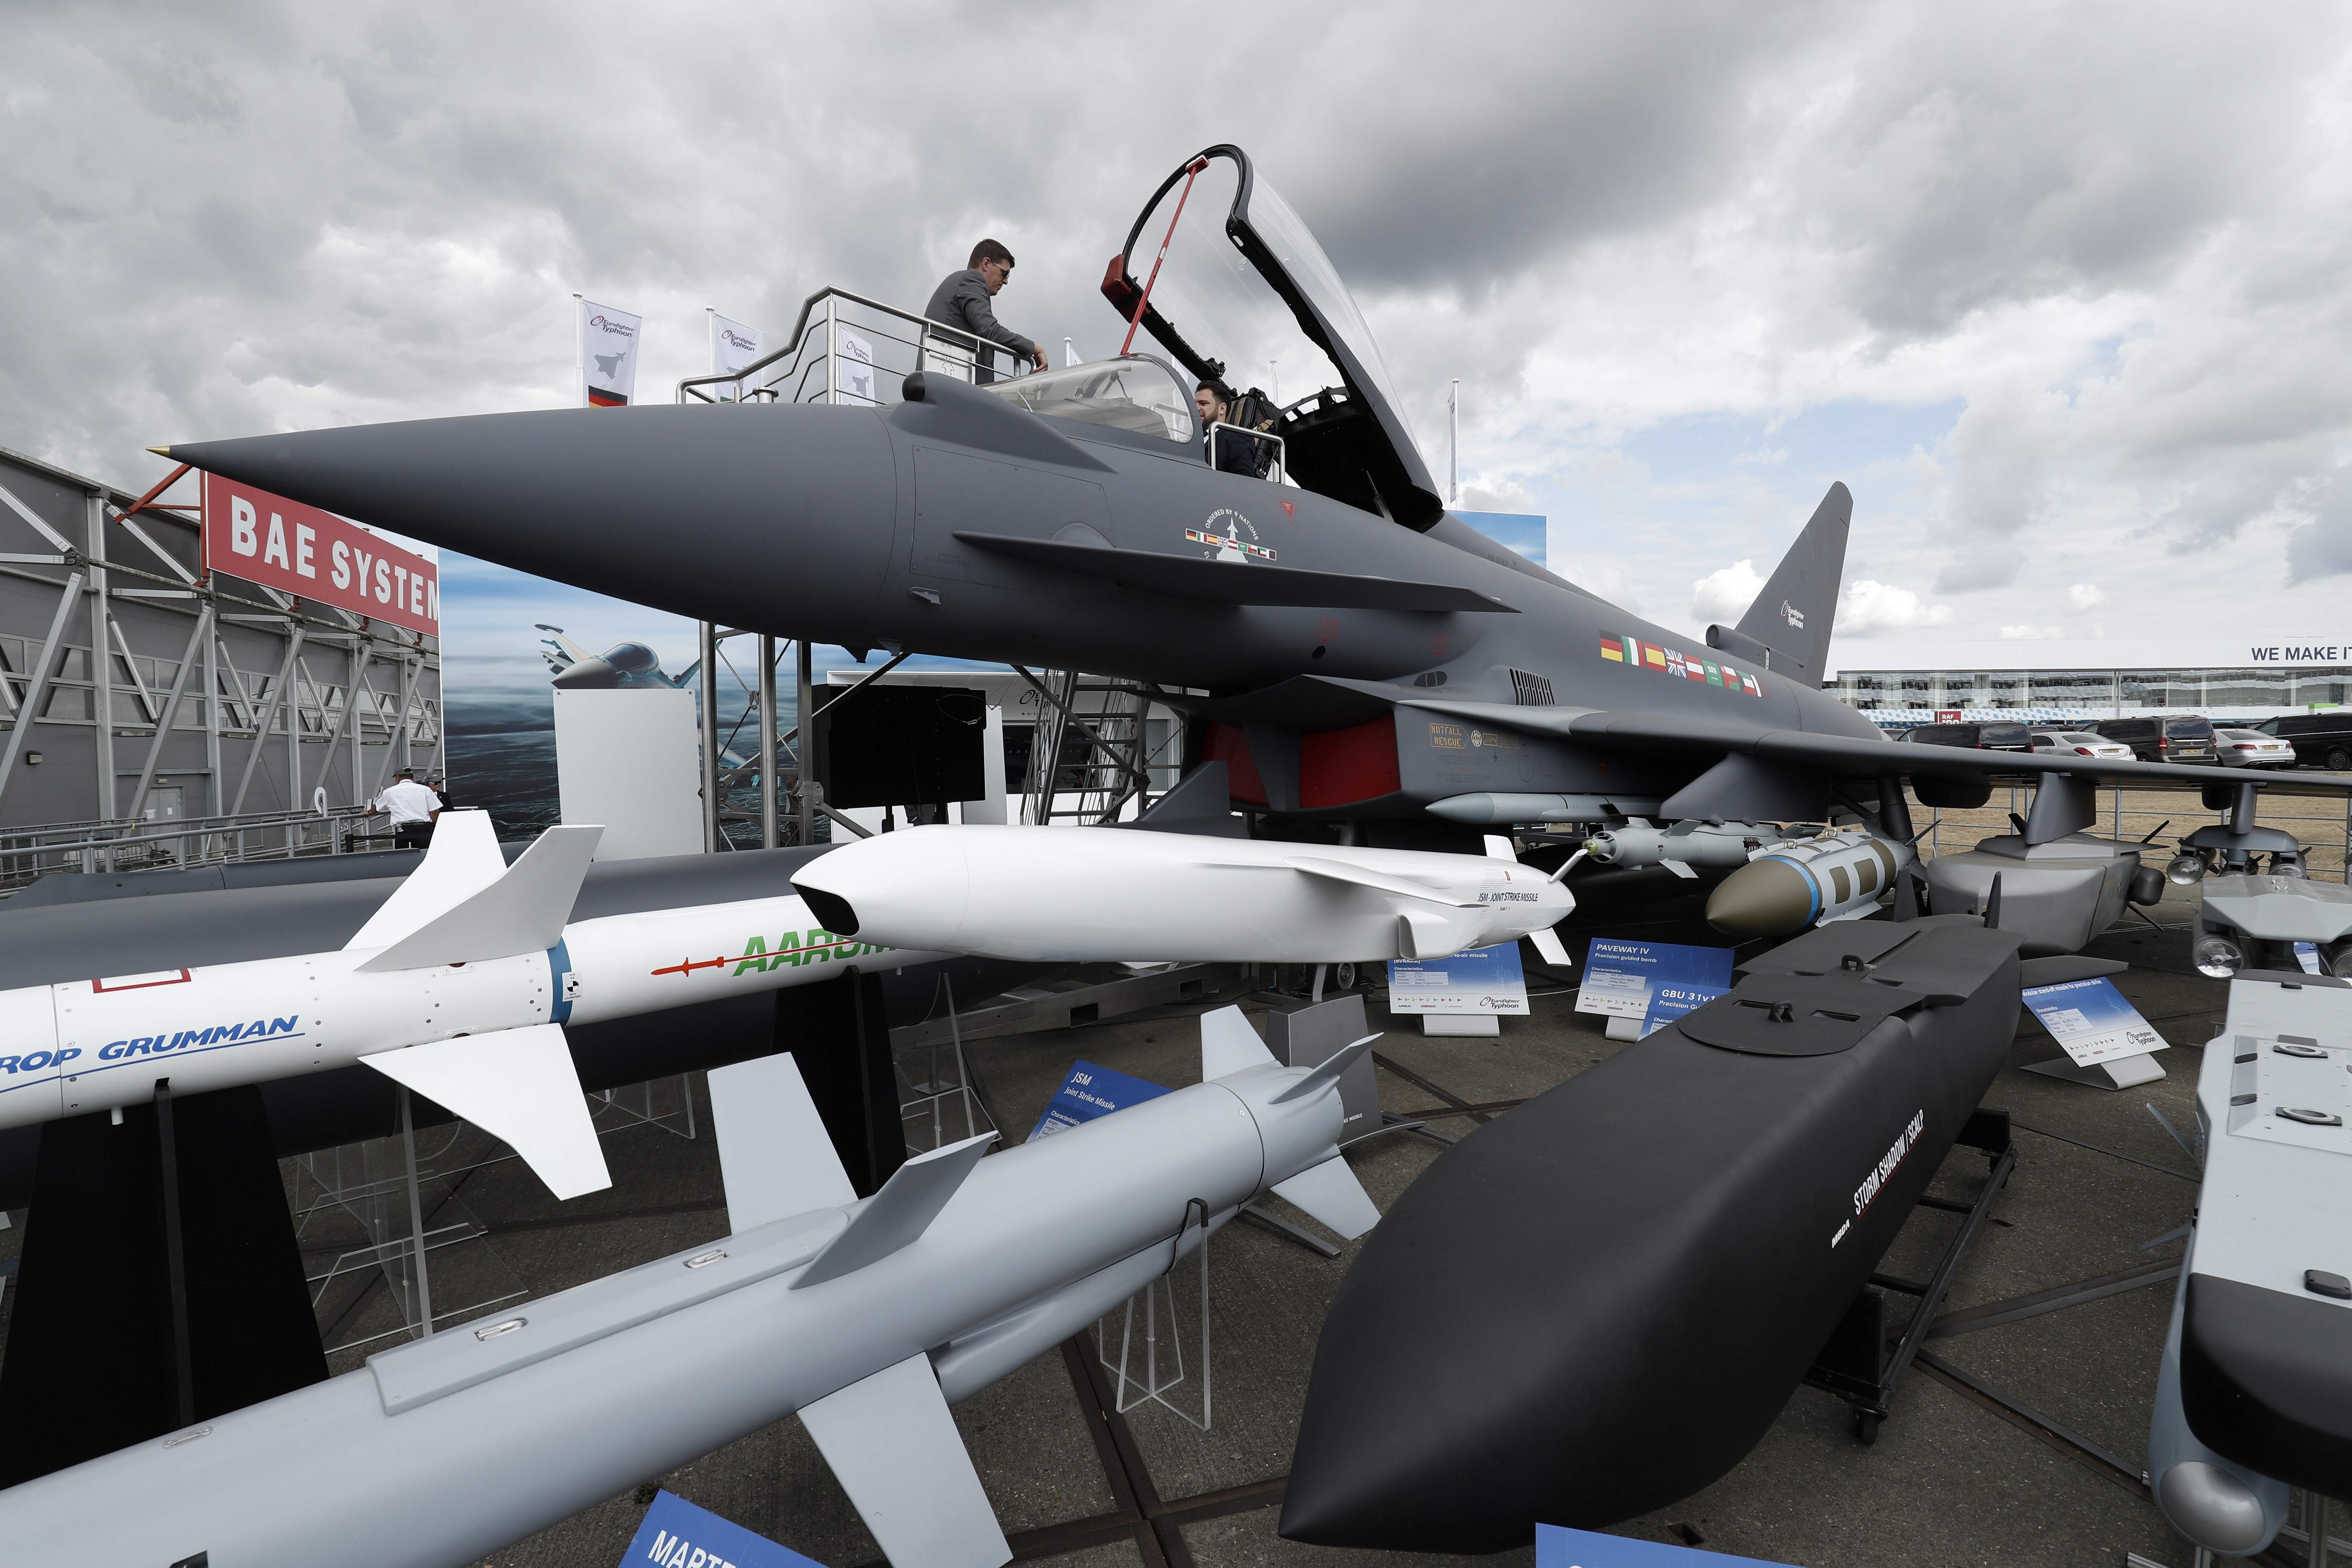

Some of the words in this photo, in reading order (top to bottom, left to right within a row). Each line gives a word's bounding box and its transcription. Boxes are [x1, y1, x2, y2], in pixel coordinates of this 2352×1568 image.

[603, 319, 634, 331] Eurofighter
[603, 324, 632, 337] Typhoon
[730, 338, 755, 352] Typhoon
[731, 334, 756, 346] Eurofighter
[1205, 509, 1225, 529] ORDERED
[1239, 514, 1259, 541] NATIONS
[231, 494, 315, 579] BAE
[1788, 613, 1803, 629] Typhoon
[2251, 647, 2279, 661] WE
[2285, 646, 2337, 660] MAKE
[1430, 725, 1461, 736] NOTFALL
[1434, 737, 1461, 747] RESCUE
[1478, 893, 1488, 902] JSM
[1490, 893, 1504, 902] JOINT
[1504, 892, 1521, 901] STRIKE
[1520, 893, 1538, 902] MISSILE
[732, 928, 897, 977] AARG
[1596, 944, 1638, 954] PAVEWAY
[1662, 989, 1685, 999] GBU
[1659, 1000, 1689, 1009] Precision
[98, 1014, 299, 1061] GRUMMAN
[2136, 1036, 2157, 1046] Typhoon
[1070, 1072, 1093, 1086] JSM
[1063, 1086, 1079, 1097] Joint
[1078, 1091, 1095, 1103] Strike
[1094, 1096, 1115, 1110] Missile
[1051, 1110, 1080, 1125] Characteristics
[1349, 1113, 1363, 1121] MISSILE
[1853, 1167, 1880, 1216] STORM
[1879, 1133, 1905, 1183] SHADOW
[1908, 1109, 1923, 1144] SCALP
[1831, 1219, 1850, 1249] MBDA
[648, 1530, 736, 1568] MART
